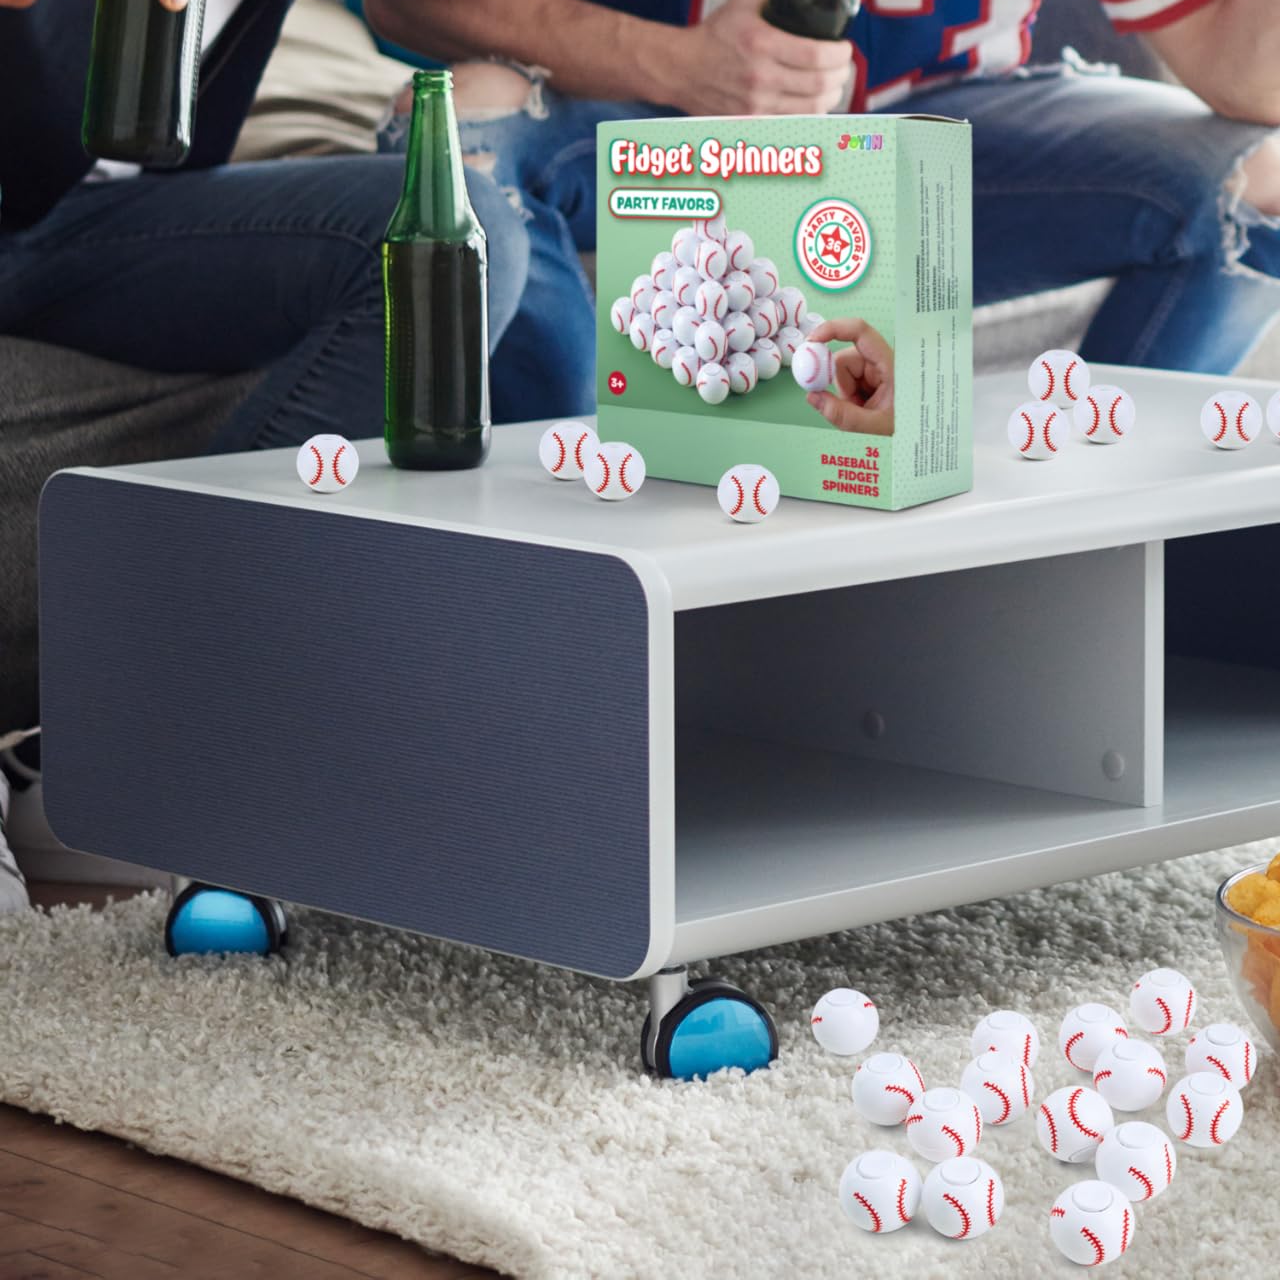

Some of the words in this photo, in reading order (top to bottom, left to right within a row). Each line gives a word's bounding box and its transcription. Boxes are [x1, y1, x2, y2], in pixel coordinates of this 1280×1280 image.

[837, 133, 883, 151] JOYIN
[609, 138, 695, 179] Fidget
[699, 137, 823, 181] Spinners
[616, 196, 660, 211] PARTY
[661, 196, 716, 212] FAVORS
[807, 211, 836, 239] PARTY
[841, 215, 862, 262] FAVORS
[825, 237, 842, 253] 36
[811, 257, 841, 278] BALLS
[610, 377, 625, 389] 3+
[865, 446, 880, 459] 36
[820, 453, 880, 471] BASEBALL
[837, 468, 880, 485] FIDGET
[822, 479, 880, 498] SPINNERS
